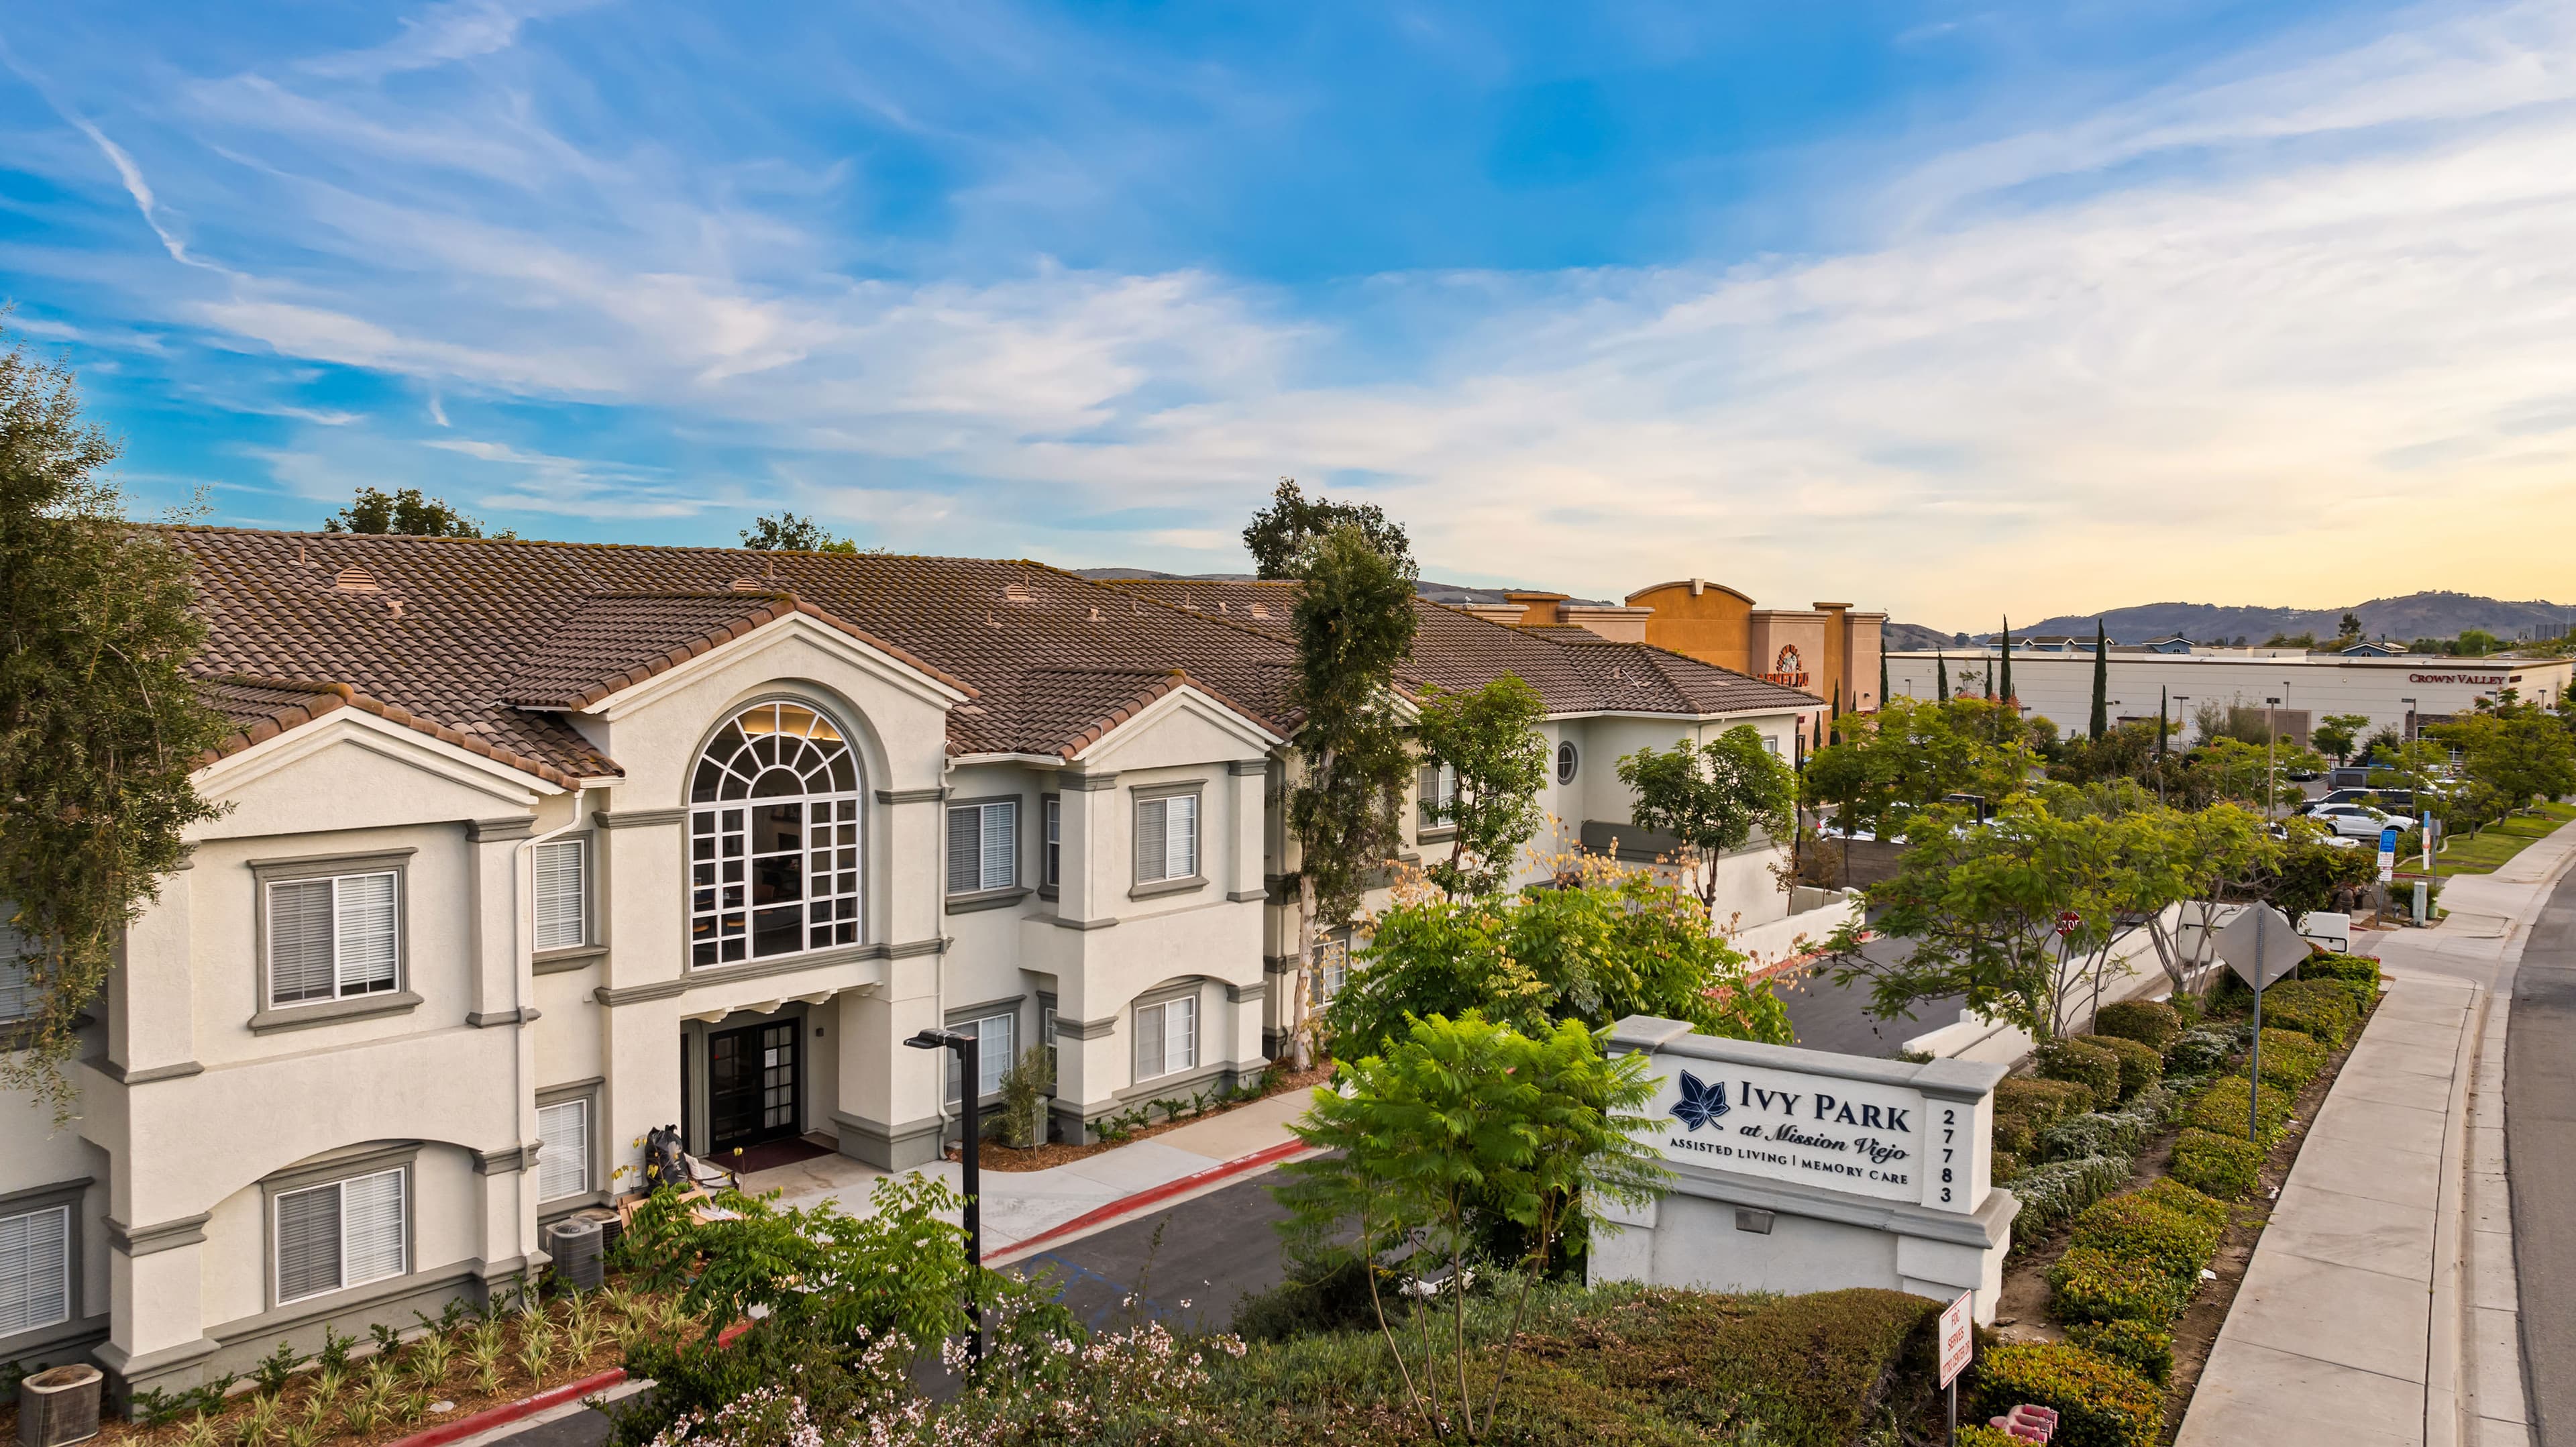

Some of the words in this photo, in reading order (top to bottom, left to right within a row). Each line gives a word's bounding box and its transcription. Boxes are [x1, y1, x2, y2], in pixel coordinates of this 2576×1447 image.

[2409, 674, 2455, 684] CROWN
[2457, 674, 2506, 685] VALLEY
[1739, 1081, 1802, 1116] IVY
[1813, 1093, 1911, 1133] PARK
[1670, 1137, 1733, 1157] ASSISTED
[1737, 1148, 1788, 1165] LIVING
[1801, 1159, 1864, 1177] MEMORY
[1869, 1170, 1909, 1185] CARE
[1739, 1124, 1763, 1138] at
[1764, 1123, 1849, 1155] Mission
[1854, 1137, 1911, 1165] Viejo
[1940, 1109, 1955, 1203] 27783
[1947, 1325, 1964, 1352] SERVES
[1953, 1345, 1966, 1368] CENTER
